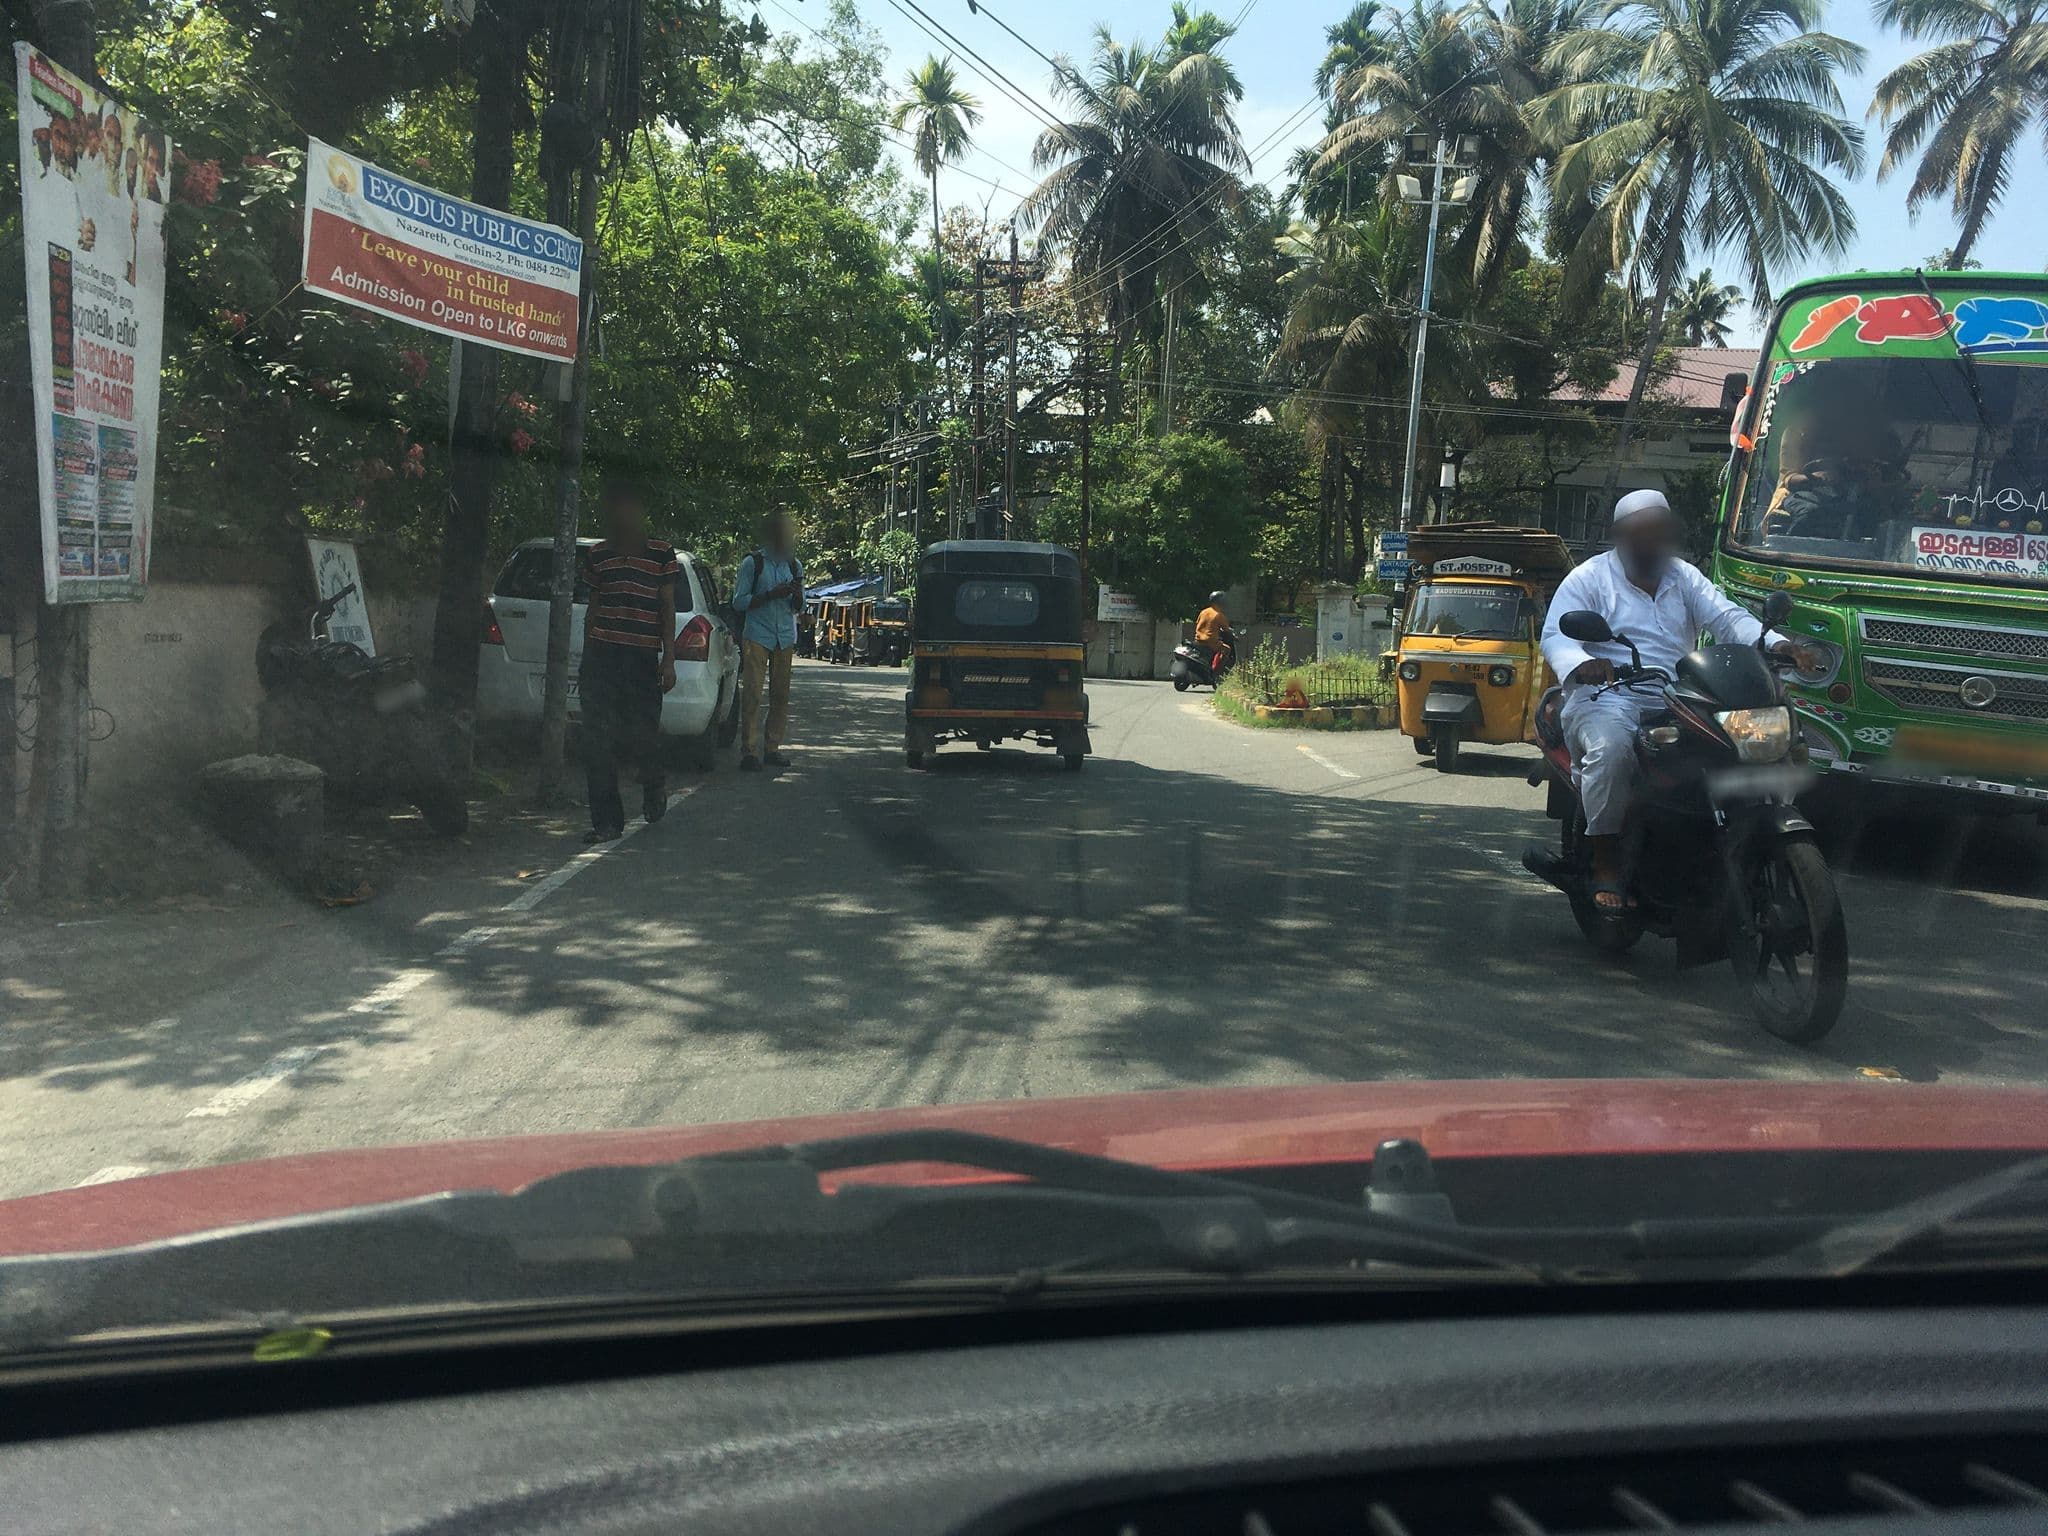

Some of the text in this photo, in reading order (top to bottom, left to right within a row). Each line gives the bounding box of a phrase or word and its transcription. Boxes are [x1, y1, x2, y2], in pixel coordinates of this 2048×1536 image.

[368, 174, 456, 228] EXODUS
[461, 210, 531, 251] PUBLIC
[397, 217, 450, 248] Nazareth,
[453, 238, 504, 266] Cochin-2,
[507, 254, 524, 269] Ph:
[526, 259, 547, 274] 0484
[421, 258, 463, 283] your
[467, 271, 509, 296] child
[447, 279, 464, 300] in
[469, 290, 524, 317] trusted
[330, 265, 568, 349] Admission Open to LKG onwards
[1918, 532, 2025, 560] ഇടപ്പള്ളി
